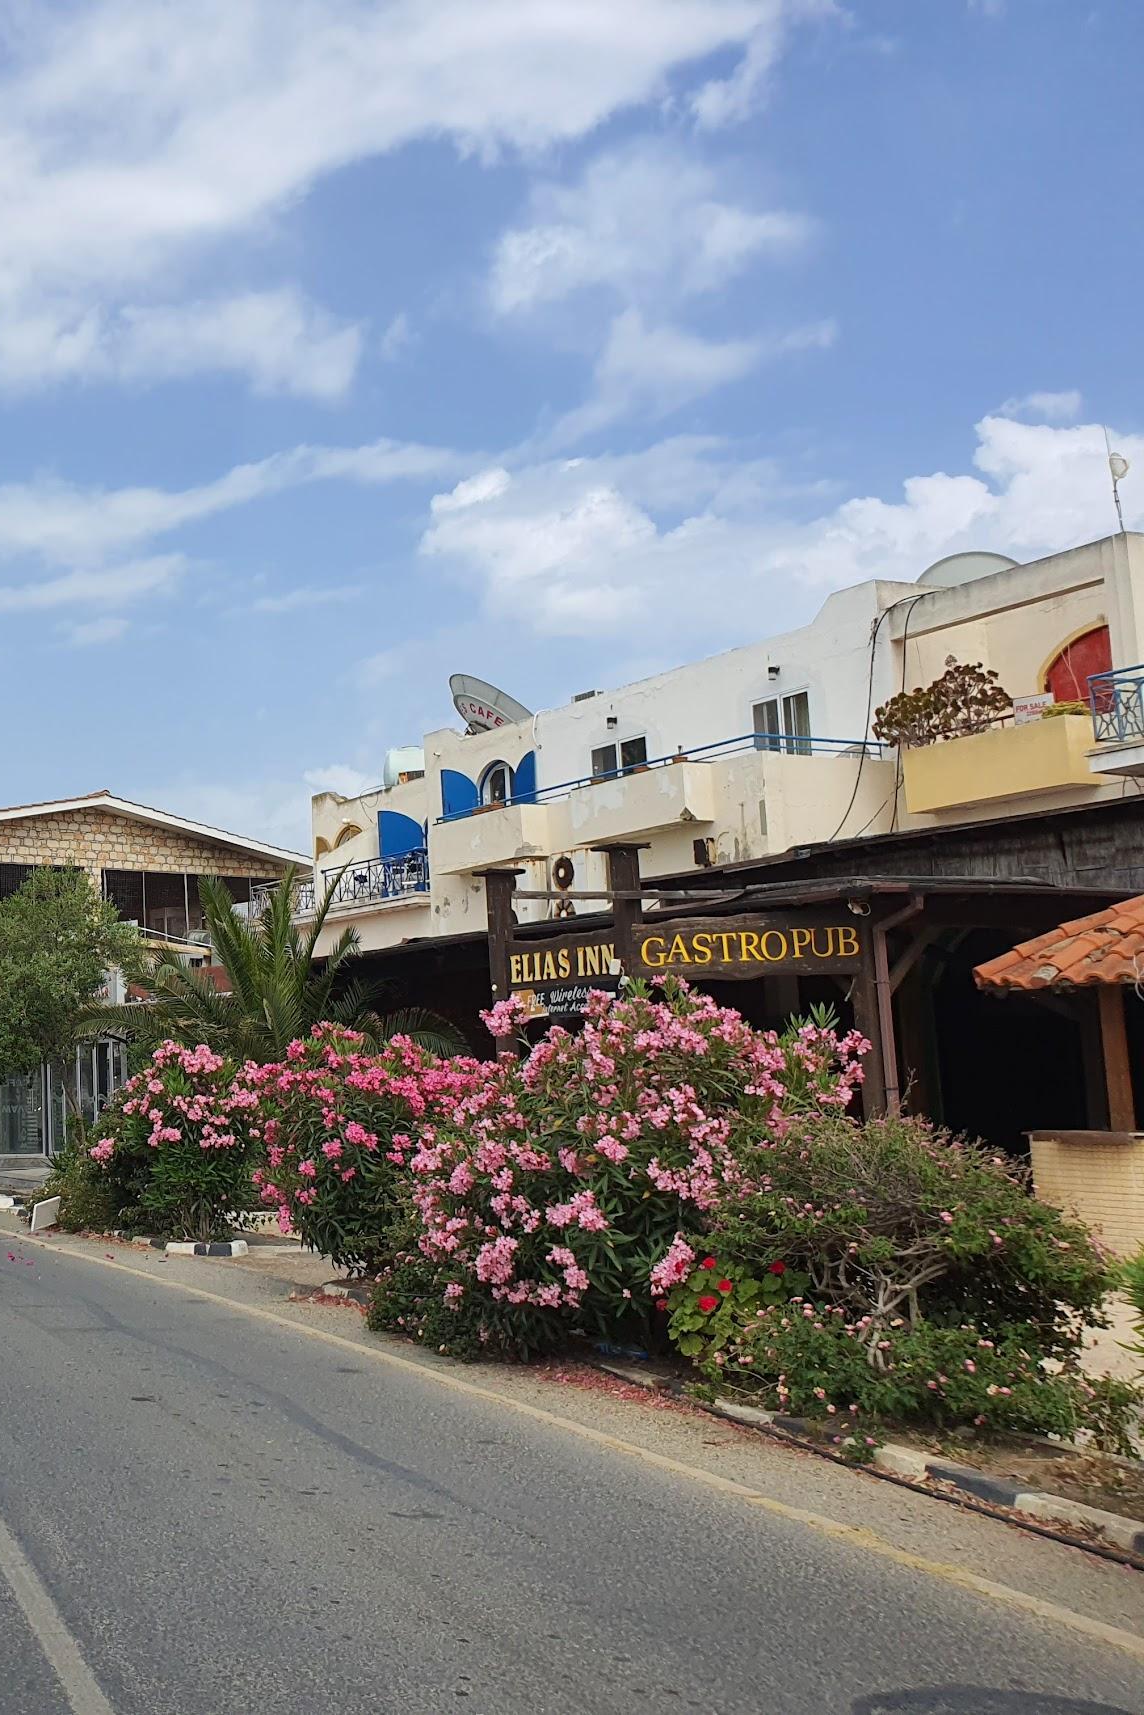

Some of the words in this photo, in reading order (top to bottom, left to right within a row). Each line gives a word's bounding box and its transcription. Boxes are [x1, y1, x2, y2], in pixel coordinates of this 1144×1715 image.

[469, 703, 505, 727] CAFE
[510, 948, 571, 983] ELIAS
[577, 943, 615, 977] INN
[640, 926, 860, 967] GASTROPUB
